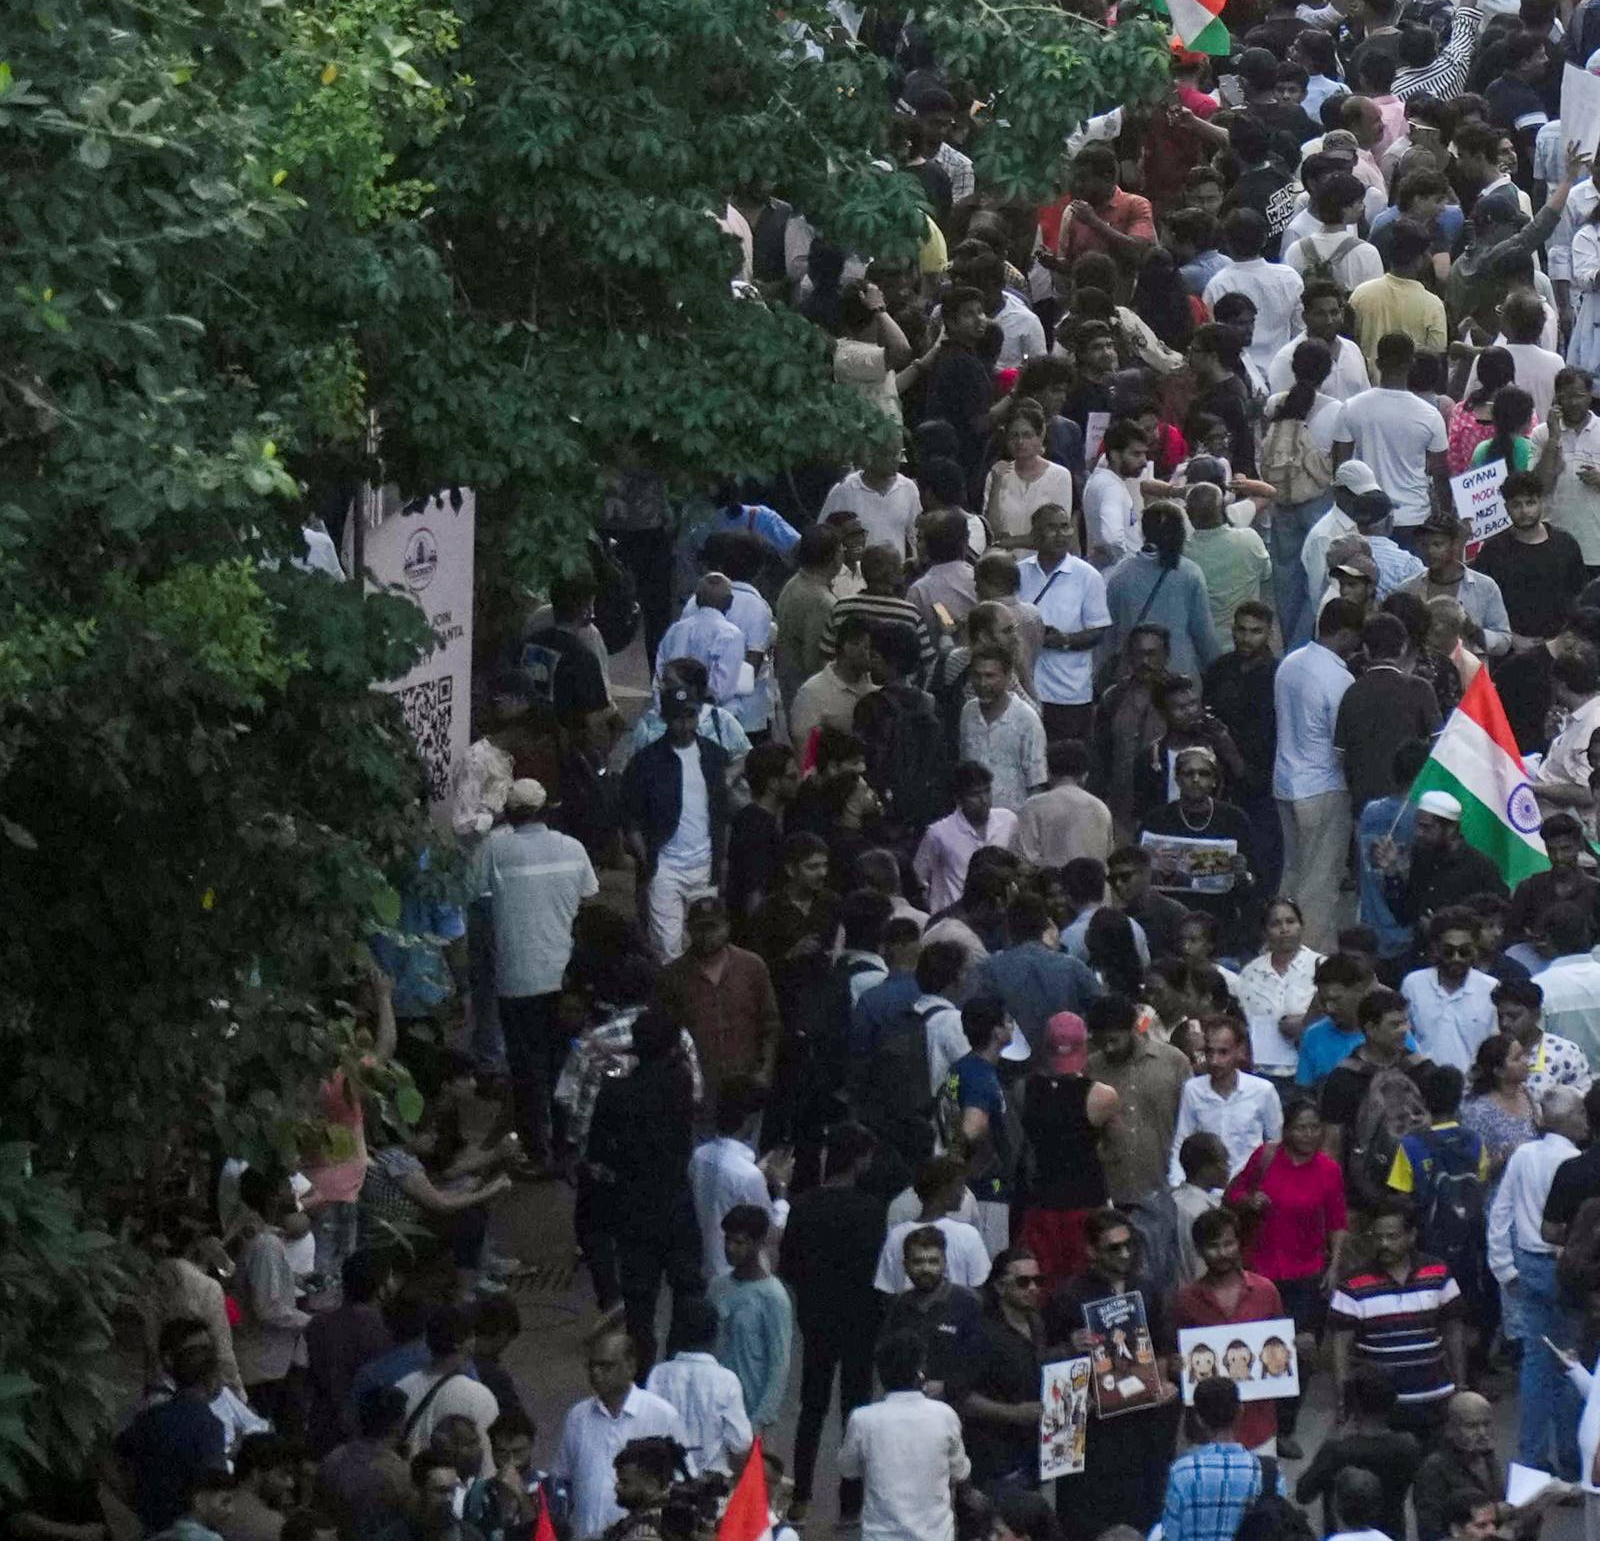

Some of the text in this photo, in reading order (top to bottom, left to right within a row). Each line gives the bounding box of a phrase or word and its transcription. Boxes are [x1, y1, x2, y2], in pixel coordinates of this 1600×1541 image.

[1462, 468, 1497, 489] GYANU
[1472, 486, 1496, 504] MODI
[1476, 503, 1499, 522] MUST
[1485, 516, 1509, 536] BACK
